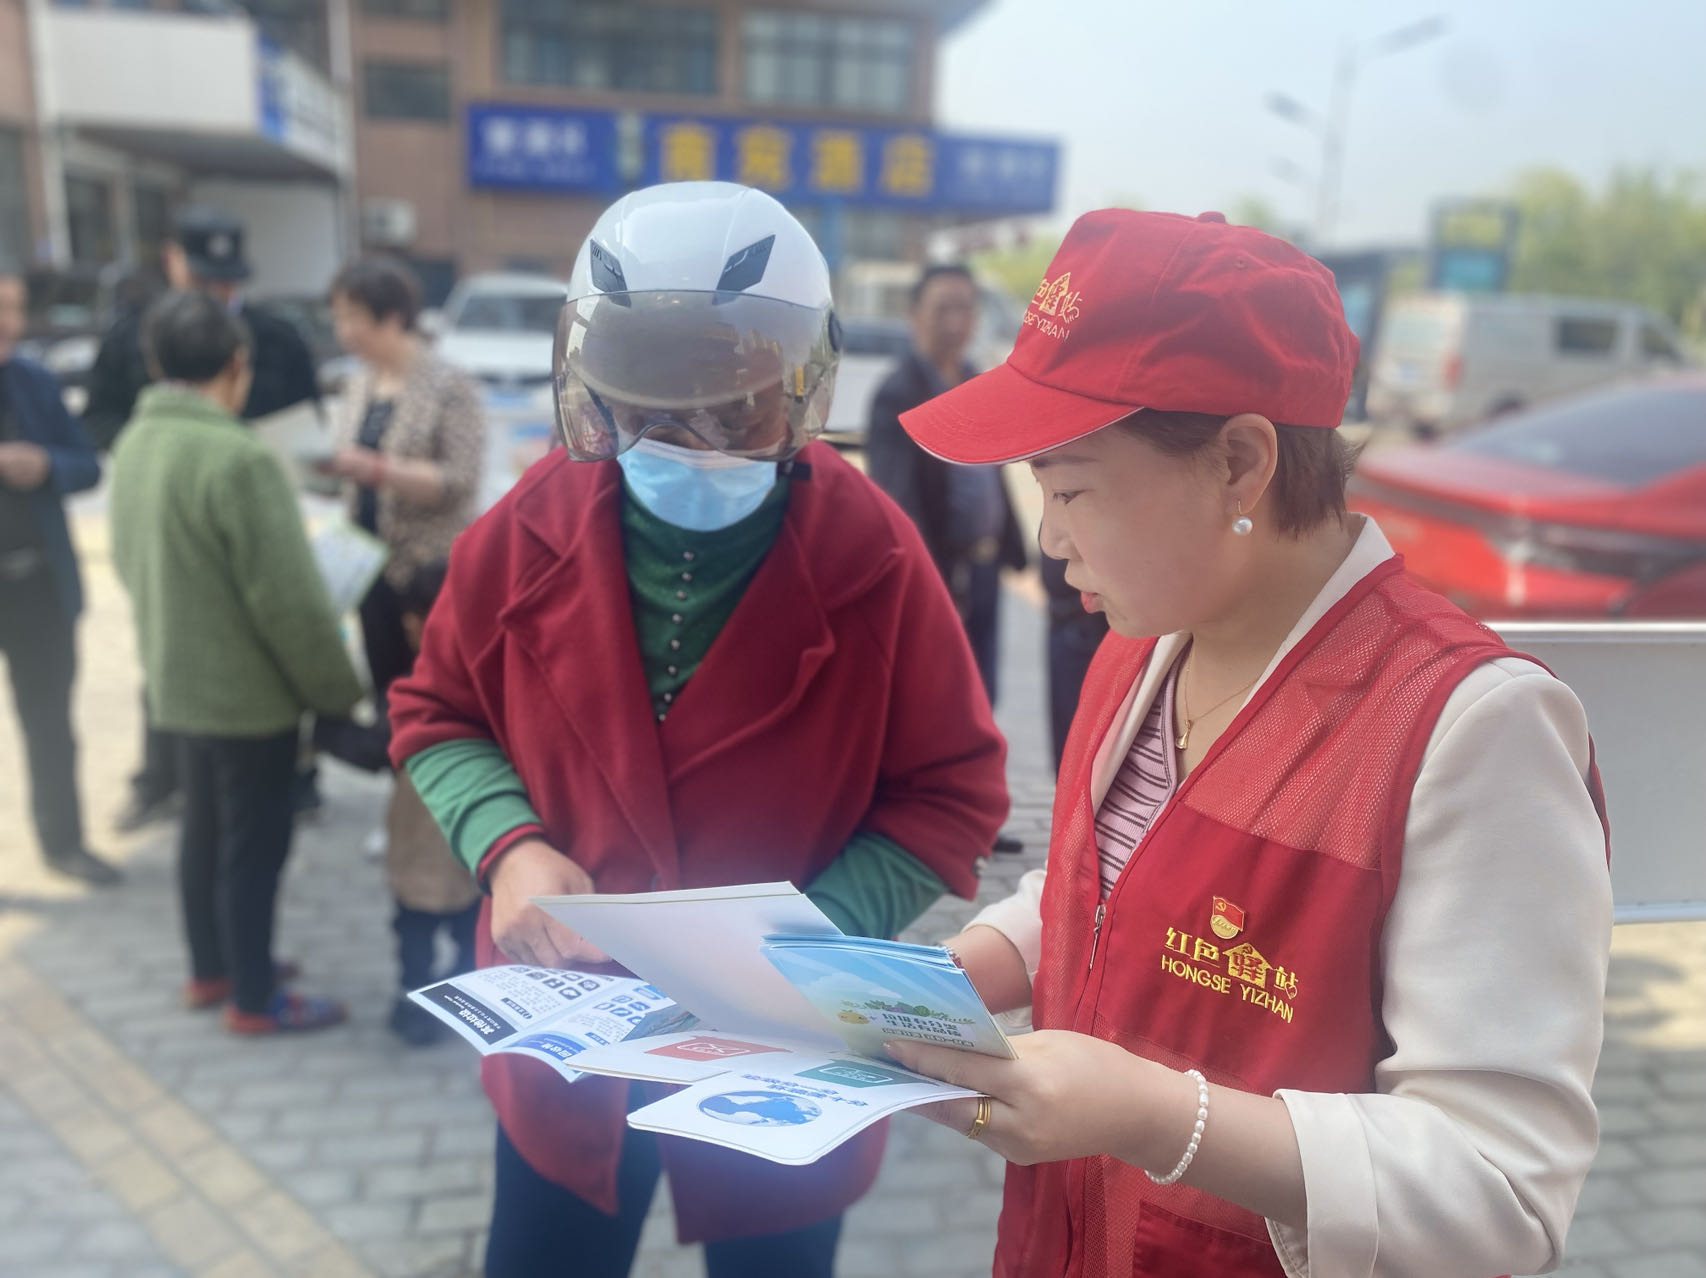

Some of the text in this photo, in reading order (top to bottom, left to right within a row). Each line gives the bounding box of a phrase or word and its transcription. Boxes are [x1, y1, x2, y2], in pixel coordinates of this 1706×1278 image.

[1161, 954, 1294, 1024] HONGSE YIZHAN
[1164, 926, 1299, 1000] 红色驿站
